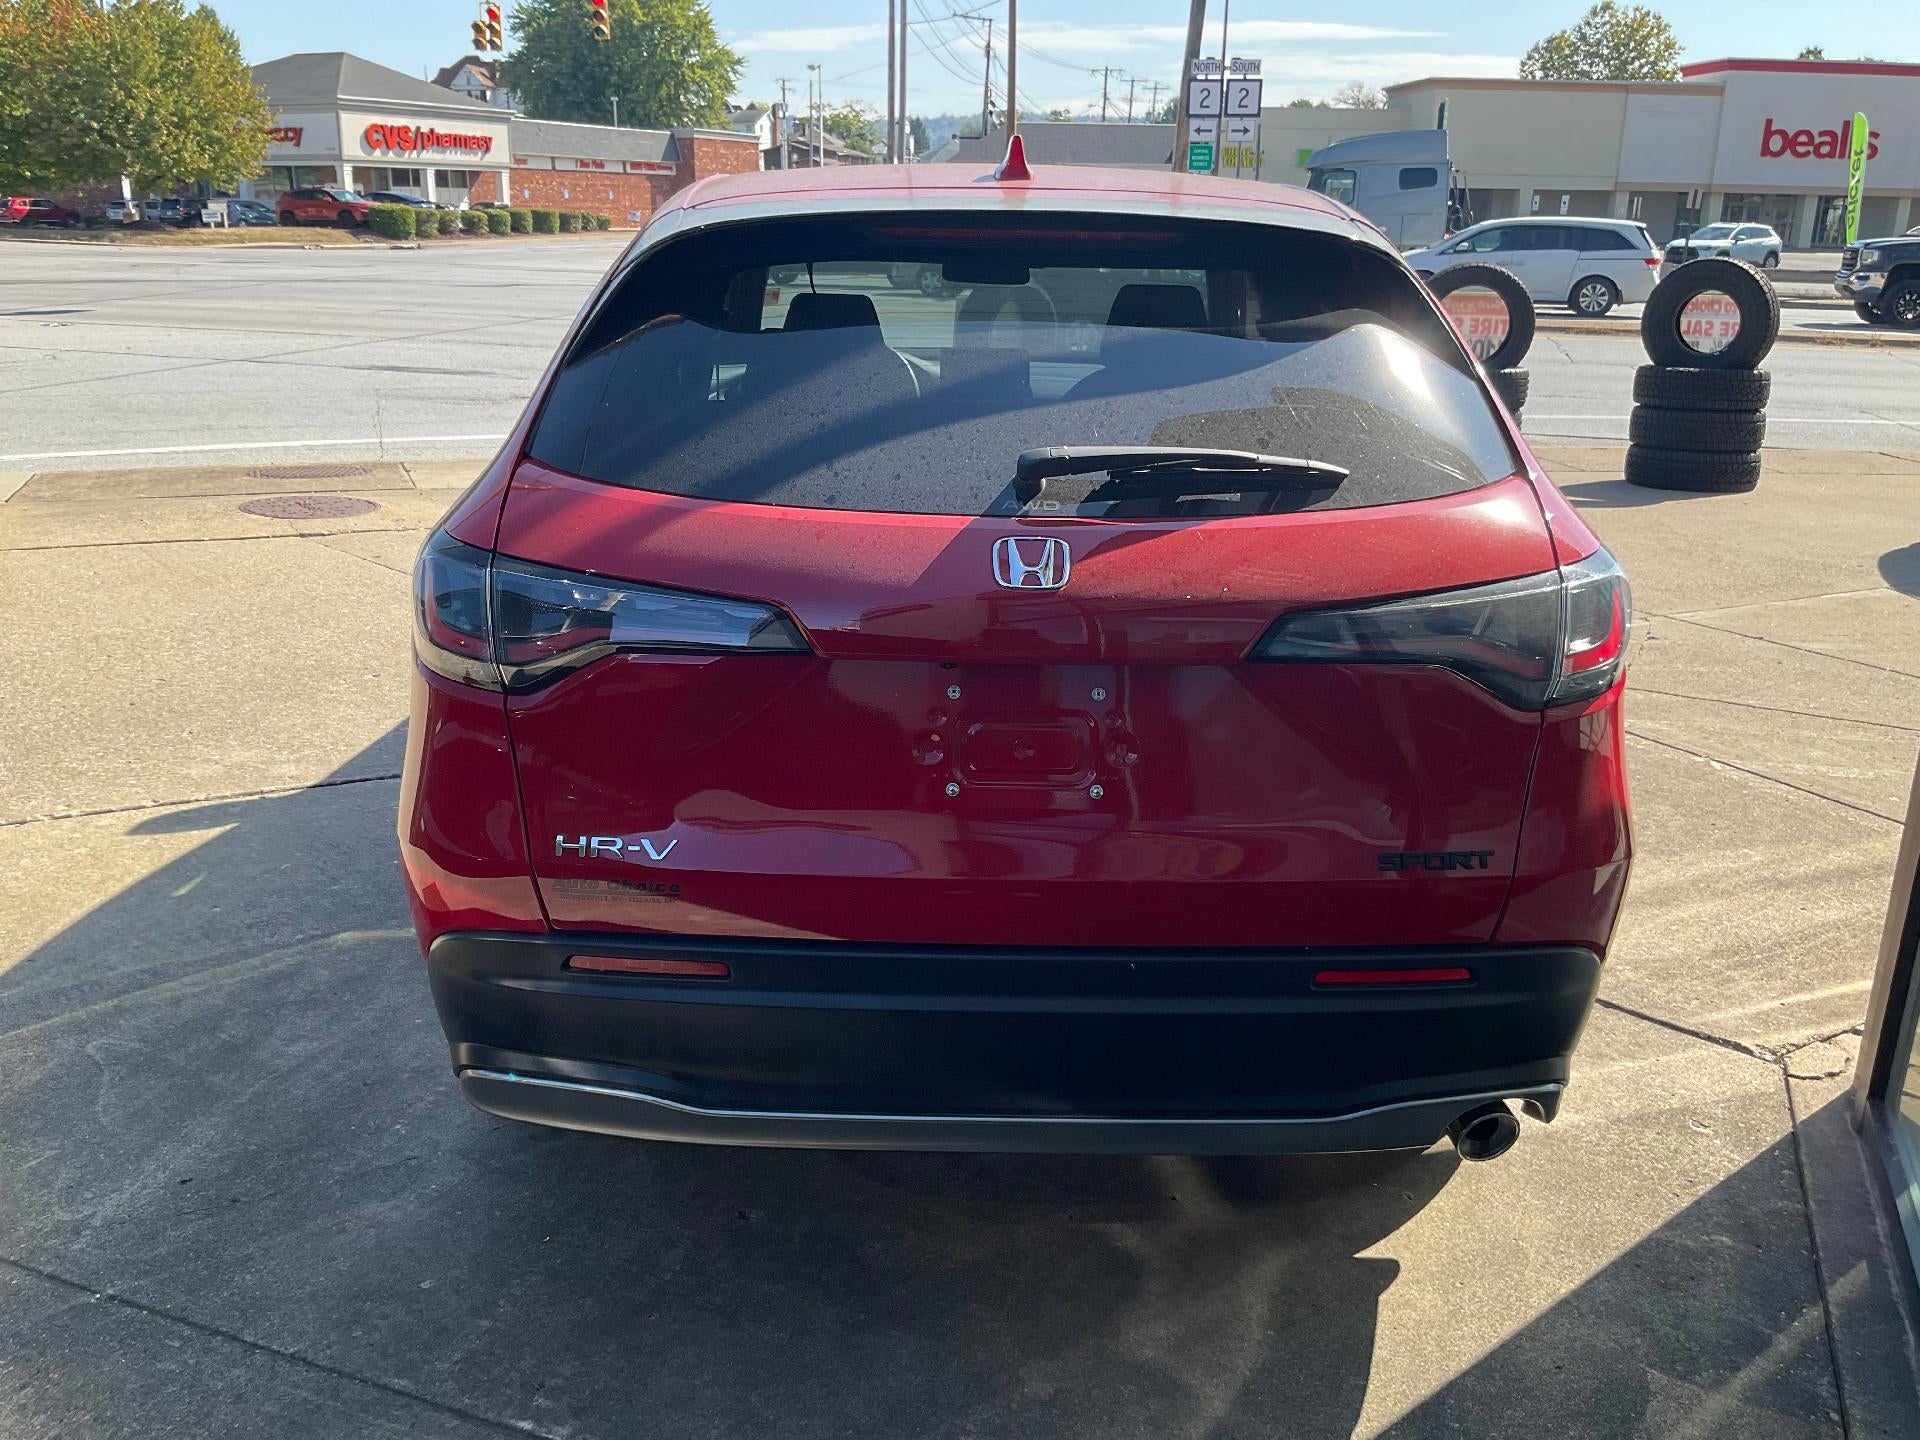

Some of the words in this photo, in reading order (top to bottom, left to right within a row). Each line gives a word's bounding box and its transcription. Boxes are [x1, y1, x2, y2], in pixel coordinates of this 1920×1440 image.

[1193, 62, 1221, 73] NORTH
[1231, 61, 1260, 73] SOUTH
[1199, 87, 1211, 109] 2
[1237, 87, 1250, 109] 2
[556, 835, 678, 860] HR-V
[1378, 850, 1495, 871] SPORT
[607, 879, 680, 893] Choice
